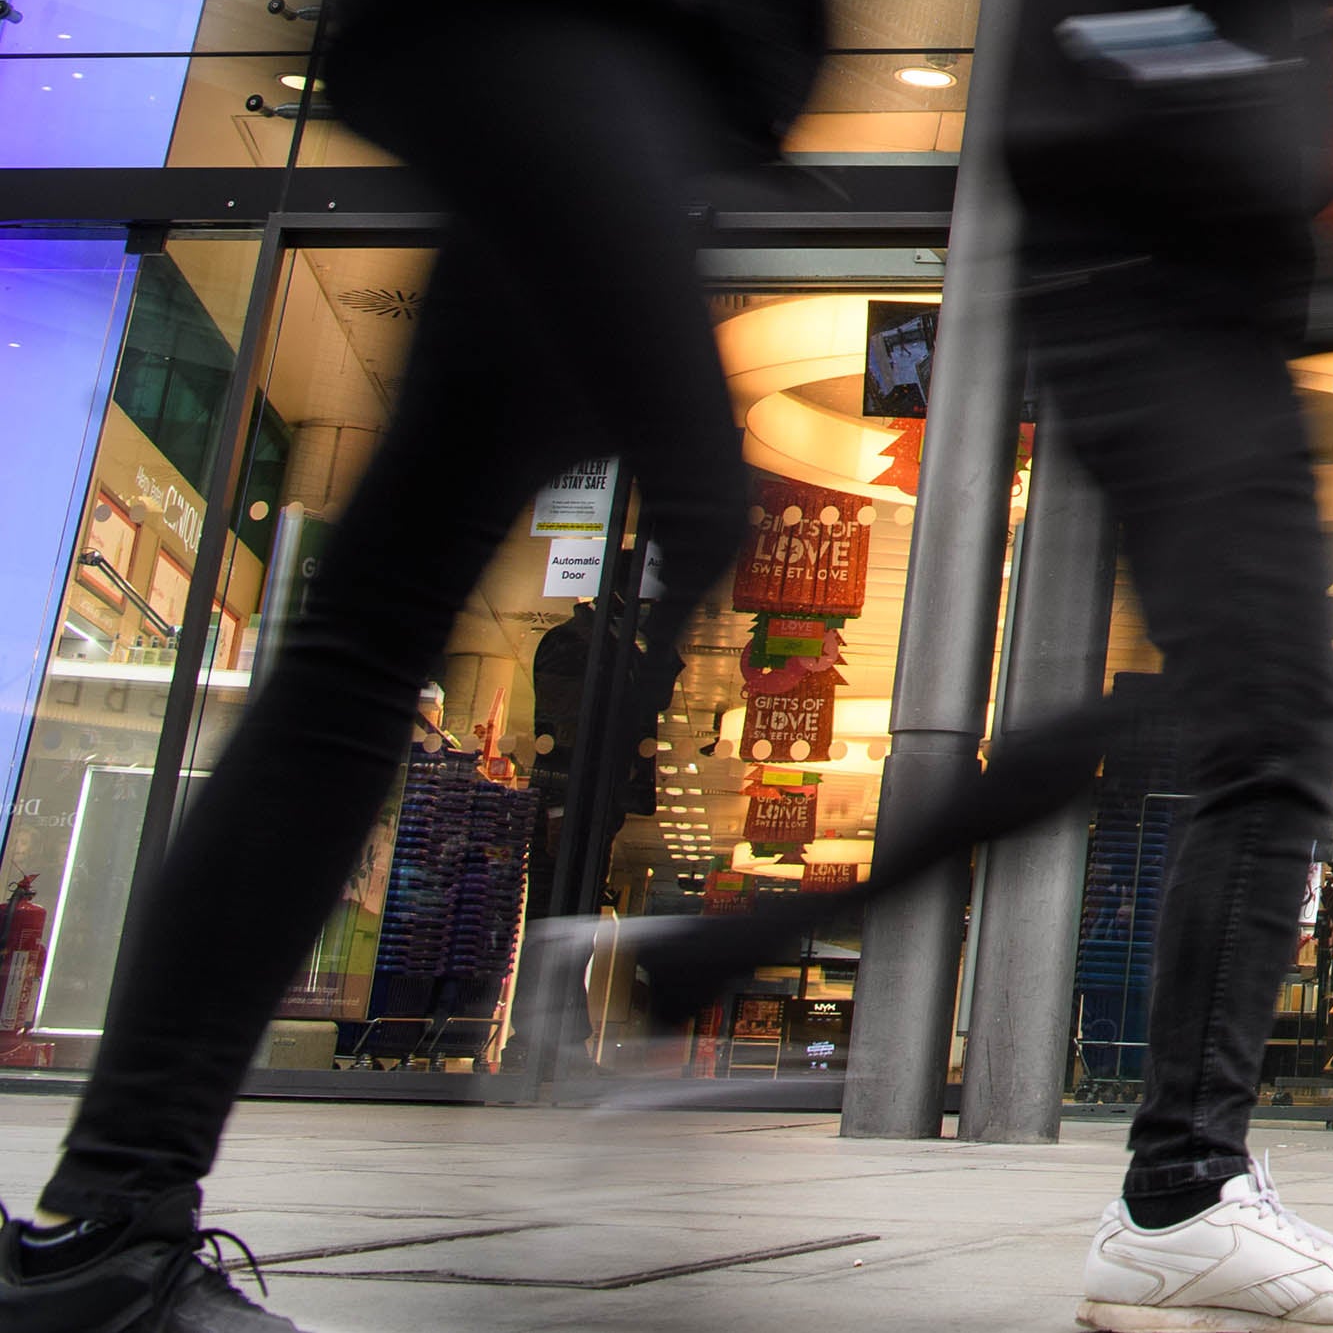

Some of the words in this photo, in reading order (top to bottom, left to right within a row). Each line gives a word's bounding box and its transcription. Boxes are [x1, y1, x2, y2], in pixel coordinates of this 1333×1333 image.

[562, 476, 584, 489] STAY
[585, 476, 607, 489] SAFE
[164, 485, 203, 554] CLINIQU
[755, 535, 850, 567] LOVE
[552, 557, 600, 565] Automatic
[562, 571, 586, 579] Door
[752, 563, 804, 578] SWEET
[806, 570, 848, 581] LOVE
[755, 696, 799, 712] GIFTS
[802, 699, 825, 712] OF
[755, 710, 819, 731] LOVE
[790, 731, 817, 741] LOVE
[815, 1003, 836, 1012] NYX
